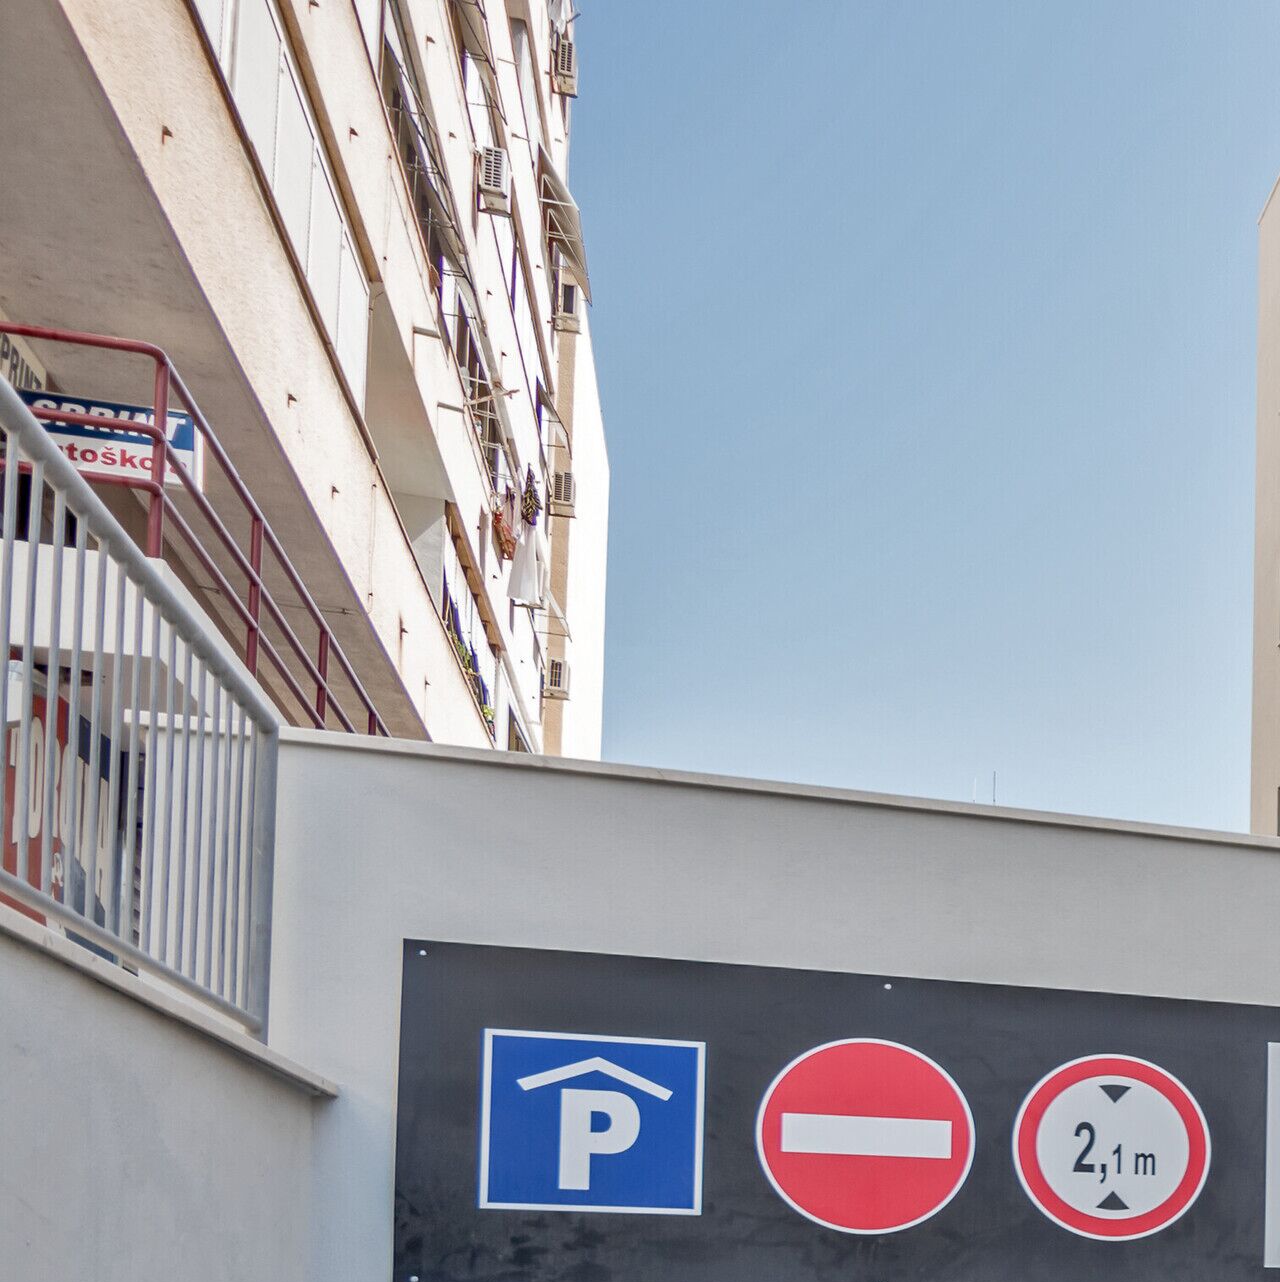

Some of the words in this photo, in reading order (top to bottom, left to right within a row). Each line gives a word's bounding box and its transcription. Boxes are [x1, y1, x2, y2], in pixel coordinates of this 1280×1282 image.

[557, 1087, 641, 1191] P
[1073, 1121, 1123, 1184] 2,1
[1134, 1152, 1156, 1176] m
